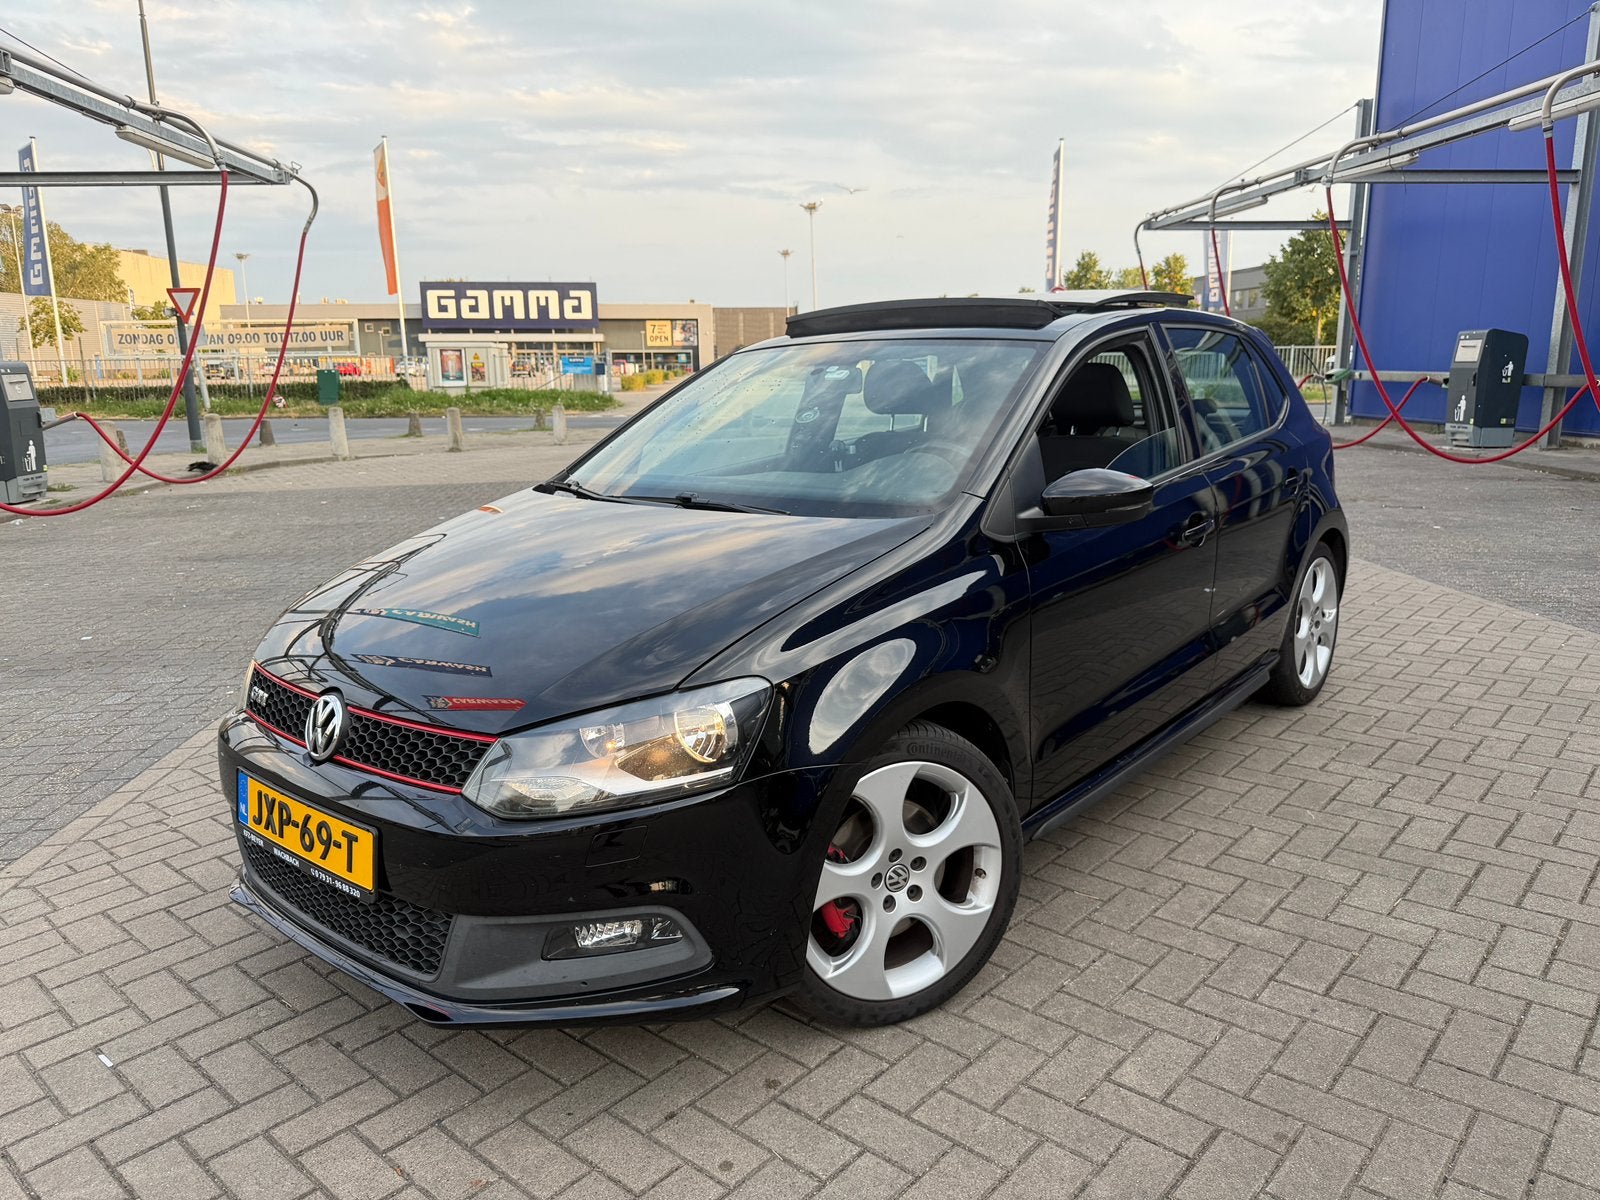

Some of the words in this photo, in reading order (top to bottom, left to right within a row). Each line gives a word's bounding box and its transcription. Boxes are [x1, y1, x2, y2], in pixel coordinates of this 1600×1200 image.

[426, 289, 593, 320] GAMMA
[650, 324, 656, 334] 7
[117, 333, 164, 345] ZONDAG
[206, 333, 225, 345] AN
[228, 332, 260, 344] 09.00
[264, 332, 285, 343] TOT
[289, 331, 316, 342] 17.00
[320, 330, 344, 341] UUR
[252, 789, 359, 874] JXP-69-T
